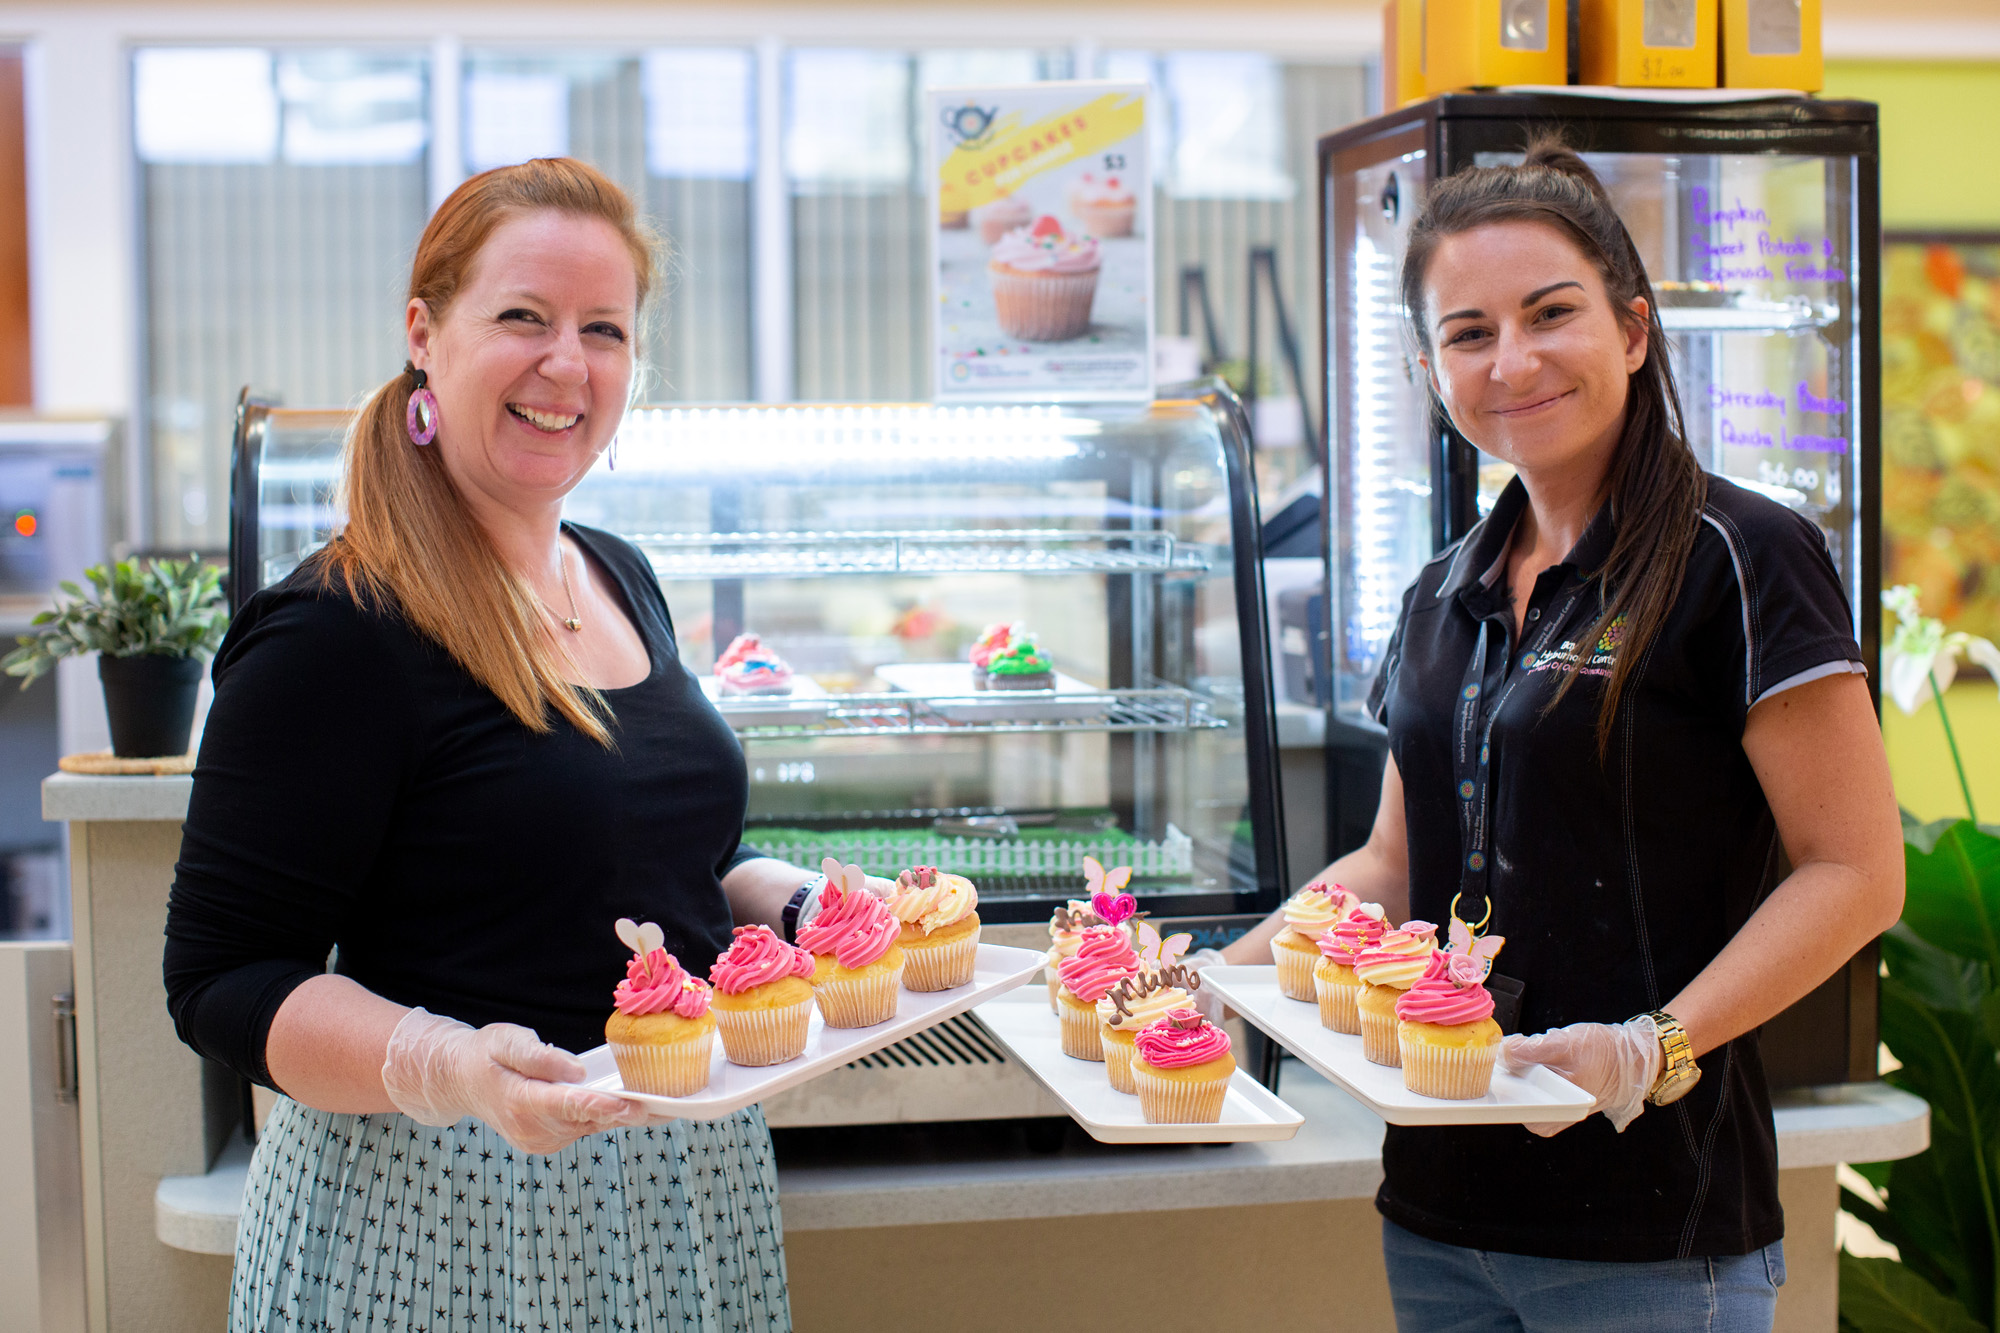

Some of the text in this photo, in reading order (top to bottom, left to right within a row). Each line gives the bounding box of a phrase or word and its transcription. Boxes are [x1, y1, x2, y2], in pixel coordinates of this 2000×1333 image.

[964, 116, 1087, 187] CUPCAKES
[1708, 383, 1787, 418] Streaky
[1592, 654, 1617, 666] Centr
